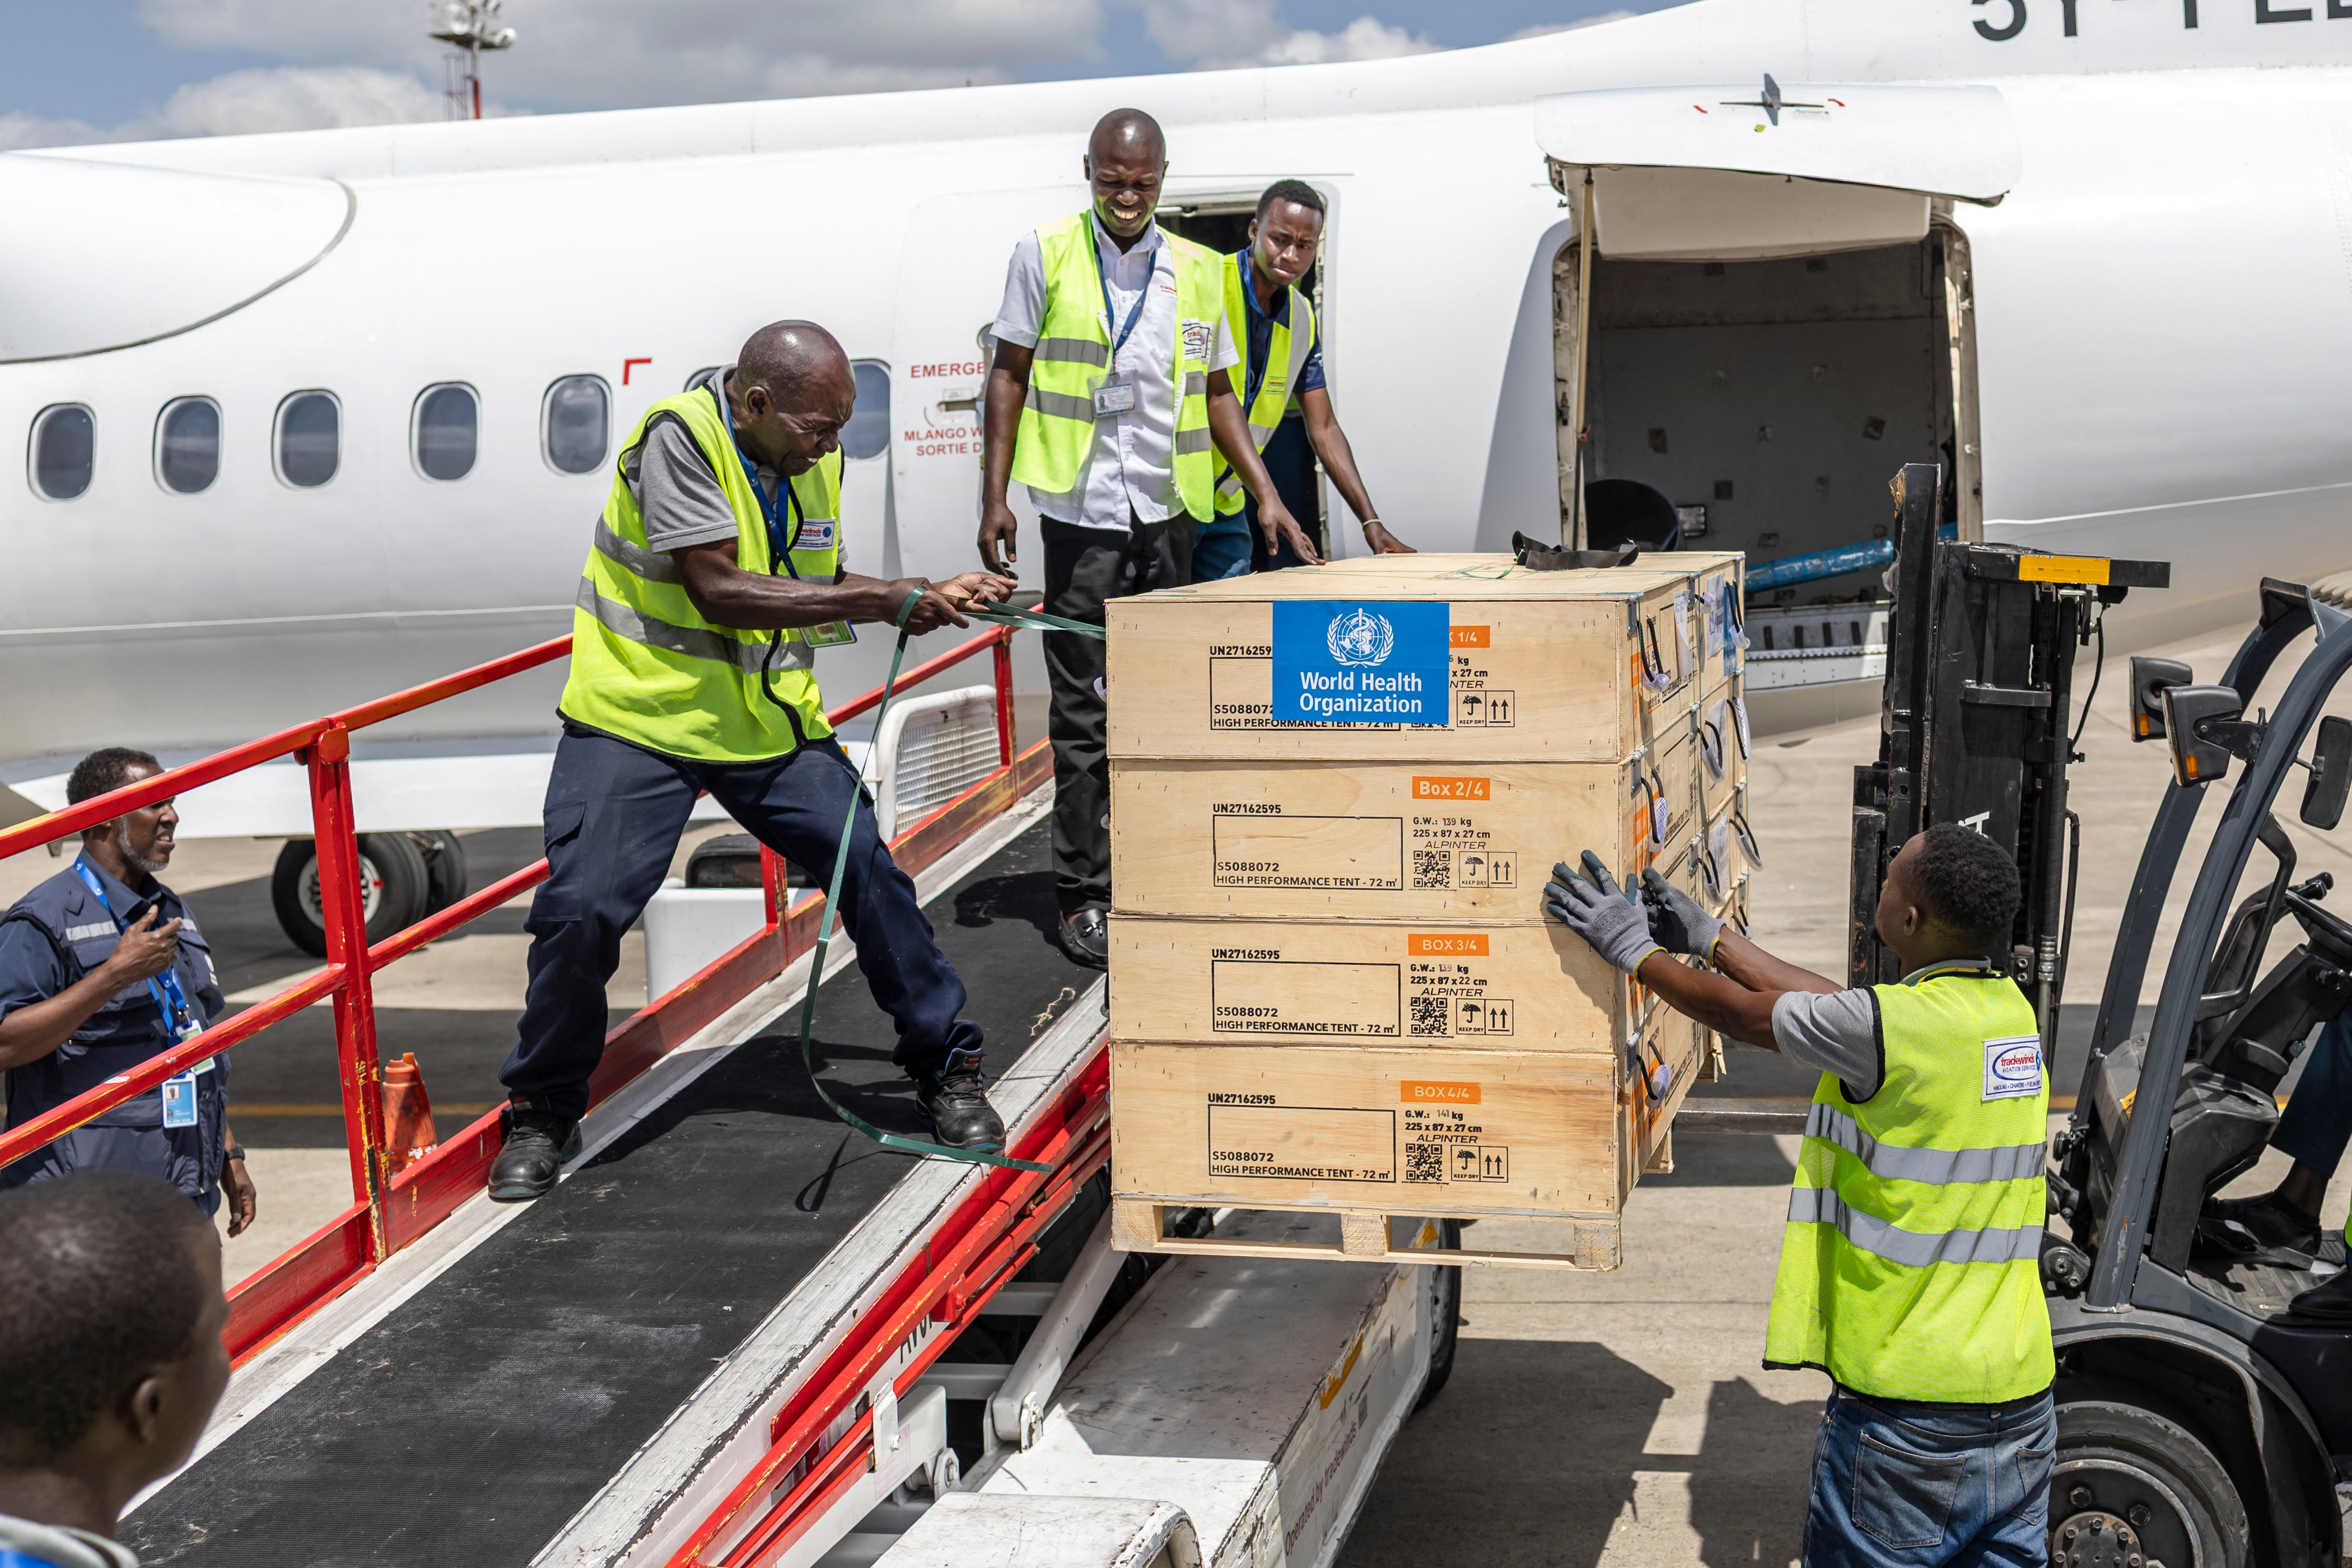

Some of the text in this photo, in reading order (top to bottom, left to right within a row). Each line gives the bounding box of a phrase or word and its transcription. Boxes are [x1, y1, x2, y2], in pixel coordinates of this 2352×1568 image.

[911, 362, 984, 378] EMERGE
[904, 426, 982, 442] MLANGO W
[916, 442, 982, 456] SORTIE D
[1458, 631, 1477, 642] 1/4
[1209, 646, 1272, 656] UN2716259
[1458, 656, 1469, 666] kg
[1460, 669, 1472, 677] 27
[1300, 671, 1422, 692] World Health
[1300, 693, 1422, 717] Organization
[1214, 718, 1241, 727] HIGH
[1244, 719, 1327, 728] PERFORMANCE
[1420, 781, 1483, 797] Box 2/4
[1213, 804, 1281, 813] UN27162595
[1460, 818, 1472, 827] kg
[1424, 841, 1486, 850] ALPINTER
[1217, 862, 1280, 872] S5088072
[1217, 876, 1244, 884] HIGH
[1247, 876, 1330, 886] PERFORMANCE
[1333, 878, 1360, 886] TENT
[1422, 940, 1477, 950] BOX 3/4
[1212, 949, 1280, 959] UN27162595
[1457, 965, 1468, 974] kg
[1421, 988, 1483, 996] ALPINTER
[1216, 1007, 1278, 1018] S5088072
[1216, 1021, 1243, 1029] HIGH
[1247, 1021, 1328, 1032] PERFORMANCE
[1331, 1024, 1358, 1033] TENT
[2001, 1053, 2034, 1066] tradewinds
[1415, 1086, 1469, 1098] BOX 4/4
[1208, 1093, 1276, 1104] UN27162595
[1405, 1109, 1463, 1121] G.W.: 141 kg
[1405, 1122, 1422, 1131] 225
[1454, 1124, 1466, 1132] 27
[1416, 1134, 1478, 1144] ALPINTER
[1212, 1151, 1274, 1162] S5088072
[1212, 1165, 1239, 1174] HIGH
[1242, 1166, 1324, 1177] PERFORMANCE
[1326, 1169, 1354, 1178] TENT
[1362, 1170, 1375, 1179] 72
[1285, 1421, 1357, 1556] Operated by tradewinds
